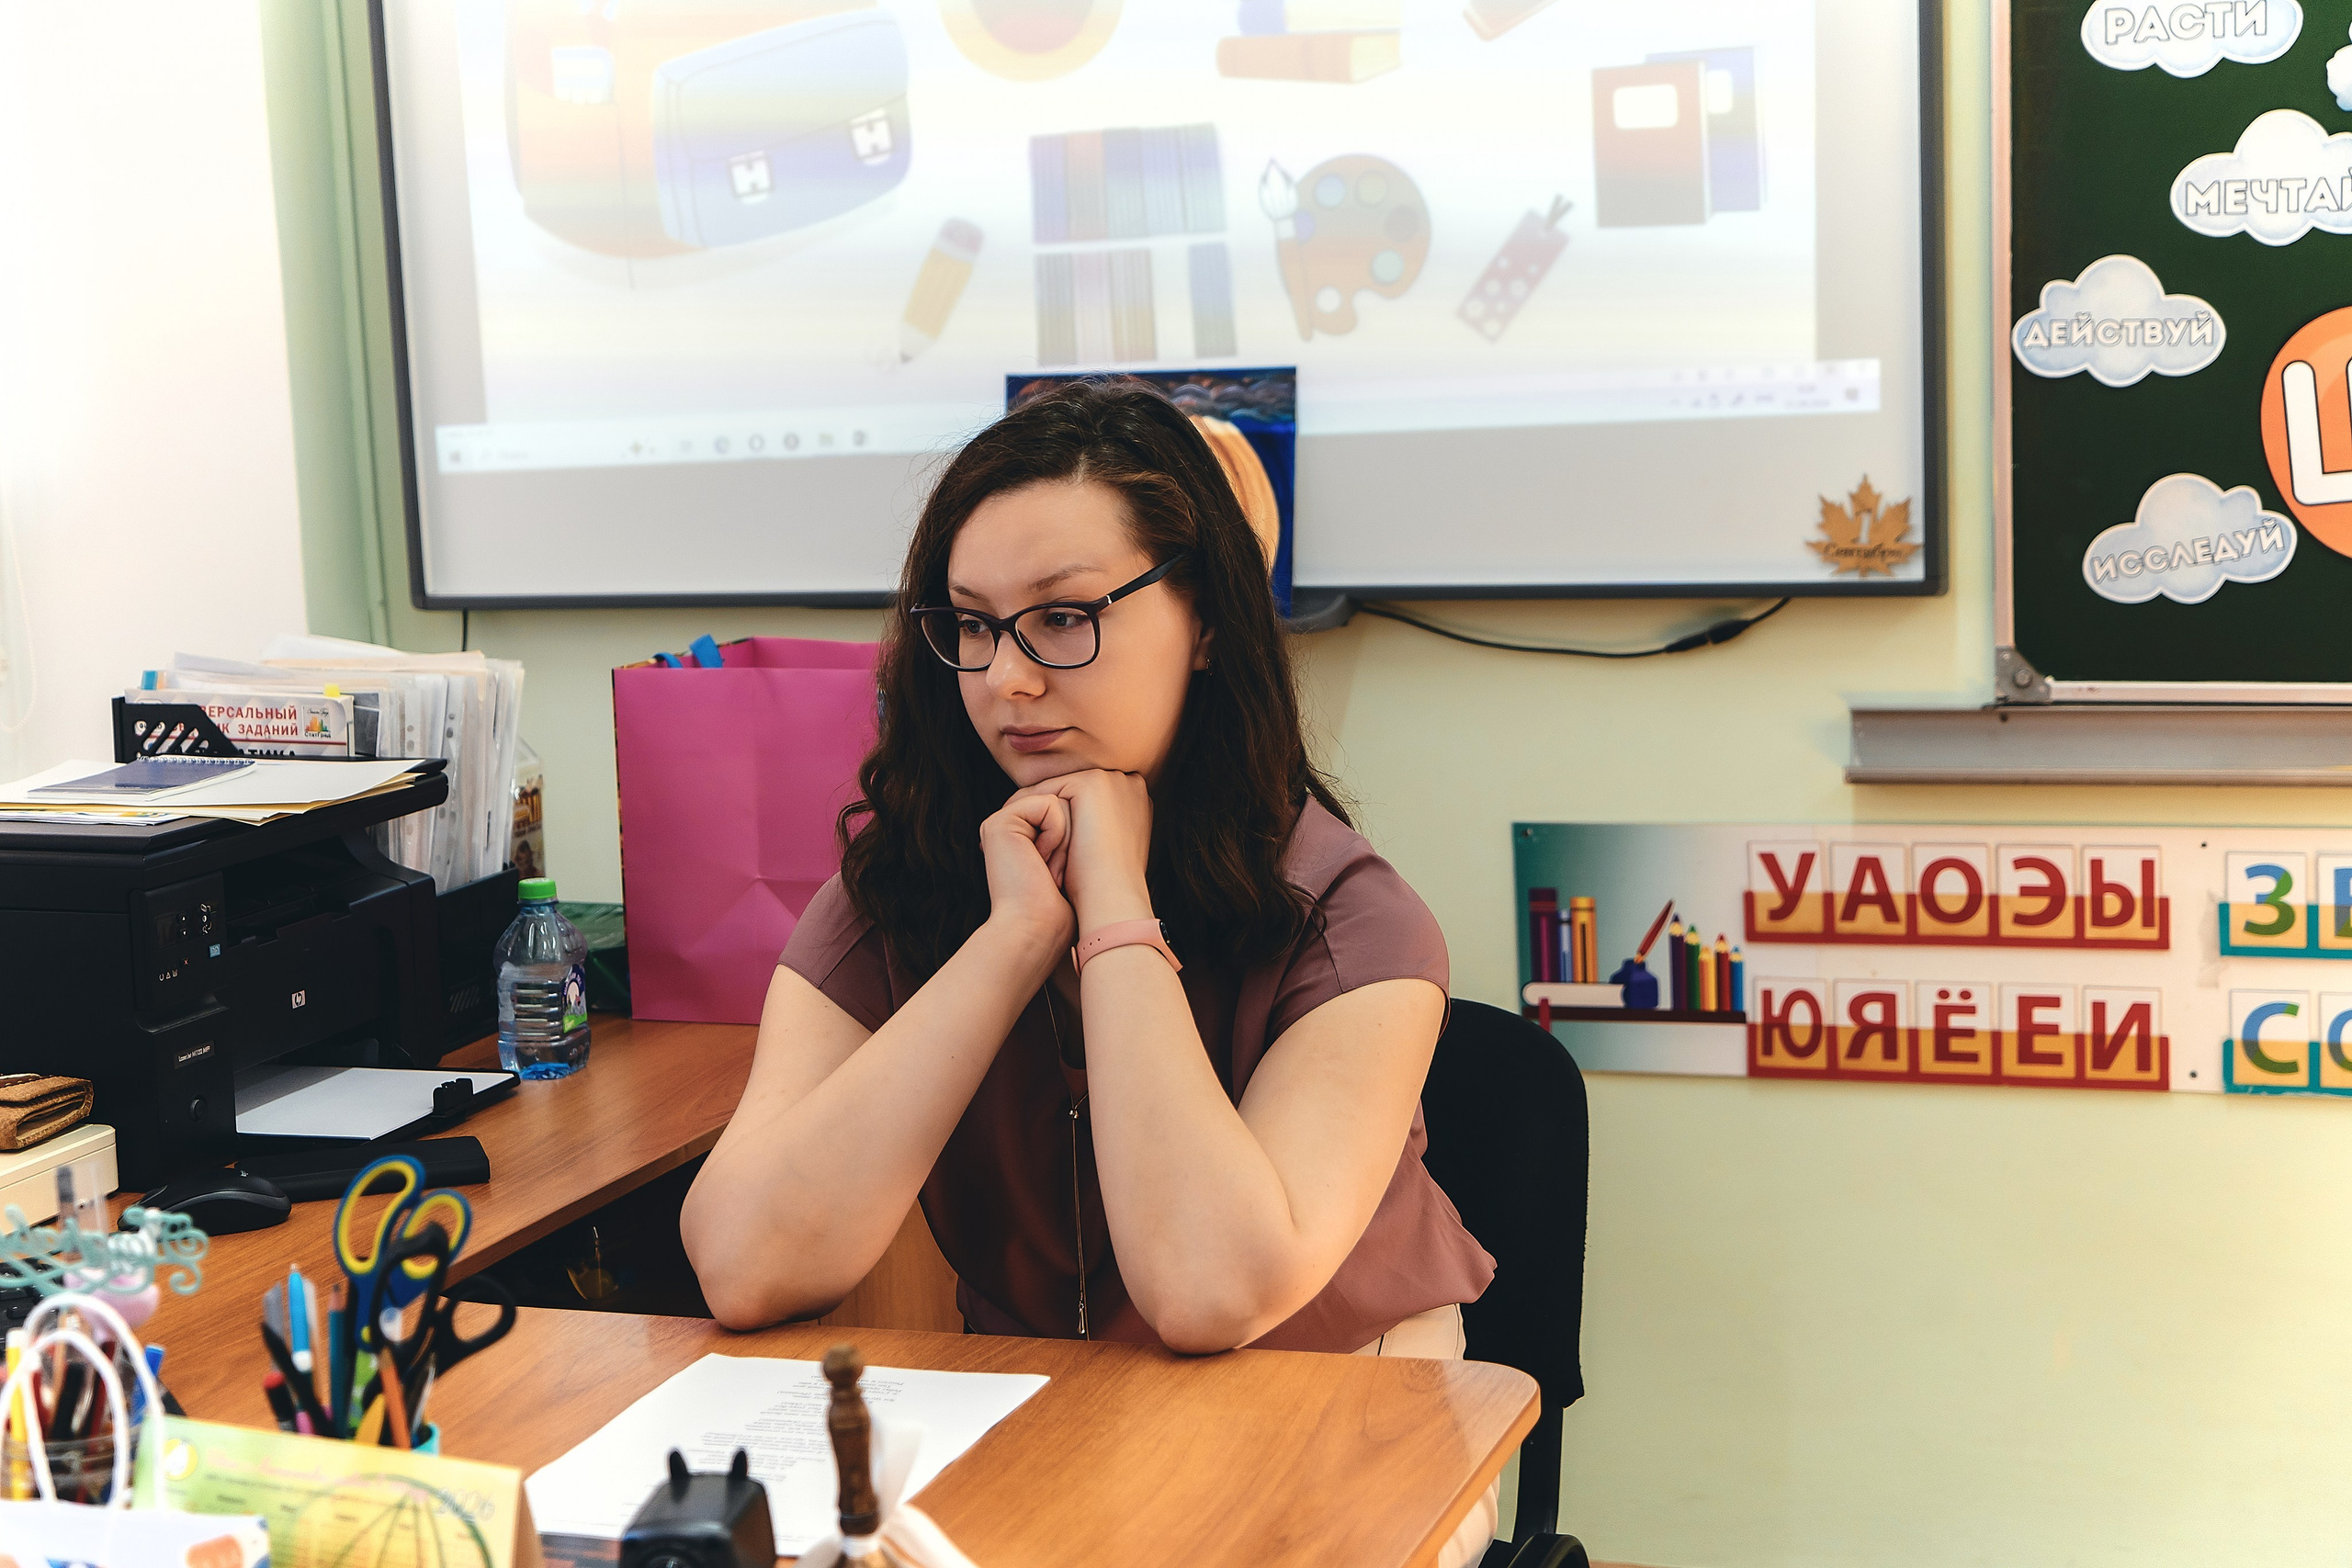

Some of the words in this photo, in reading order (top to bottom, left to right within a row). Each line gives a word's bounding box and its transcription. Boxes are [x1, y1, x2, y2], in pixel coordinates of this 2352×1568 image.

[2105, 0, 2267, 45] РАСТИ
[2023, 310, 2214, 350] ДЕЙСТВУЙ
[2091, 517, 2285, 584] ИССЛЕДУЙ
[238, 722, 299, 737] ЗАДАНИЙ
